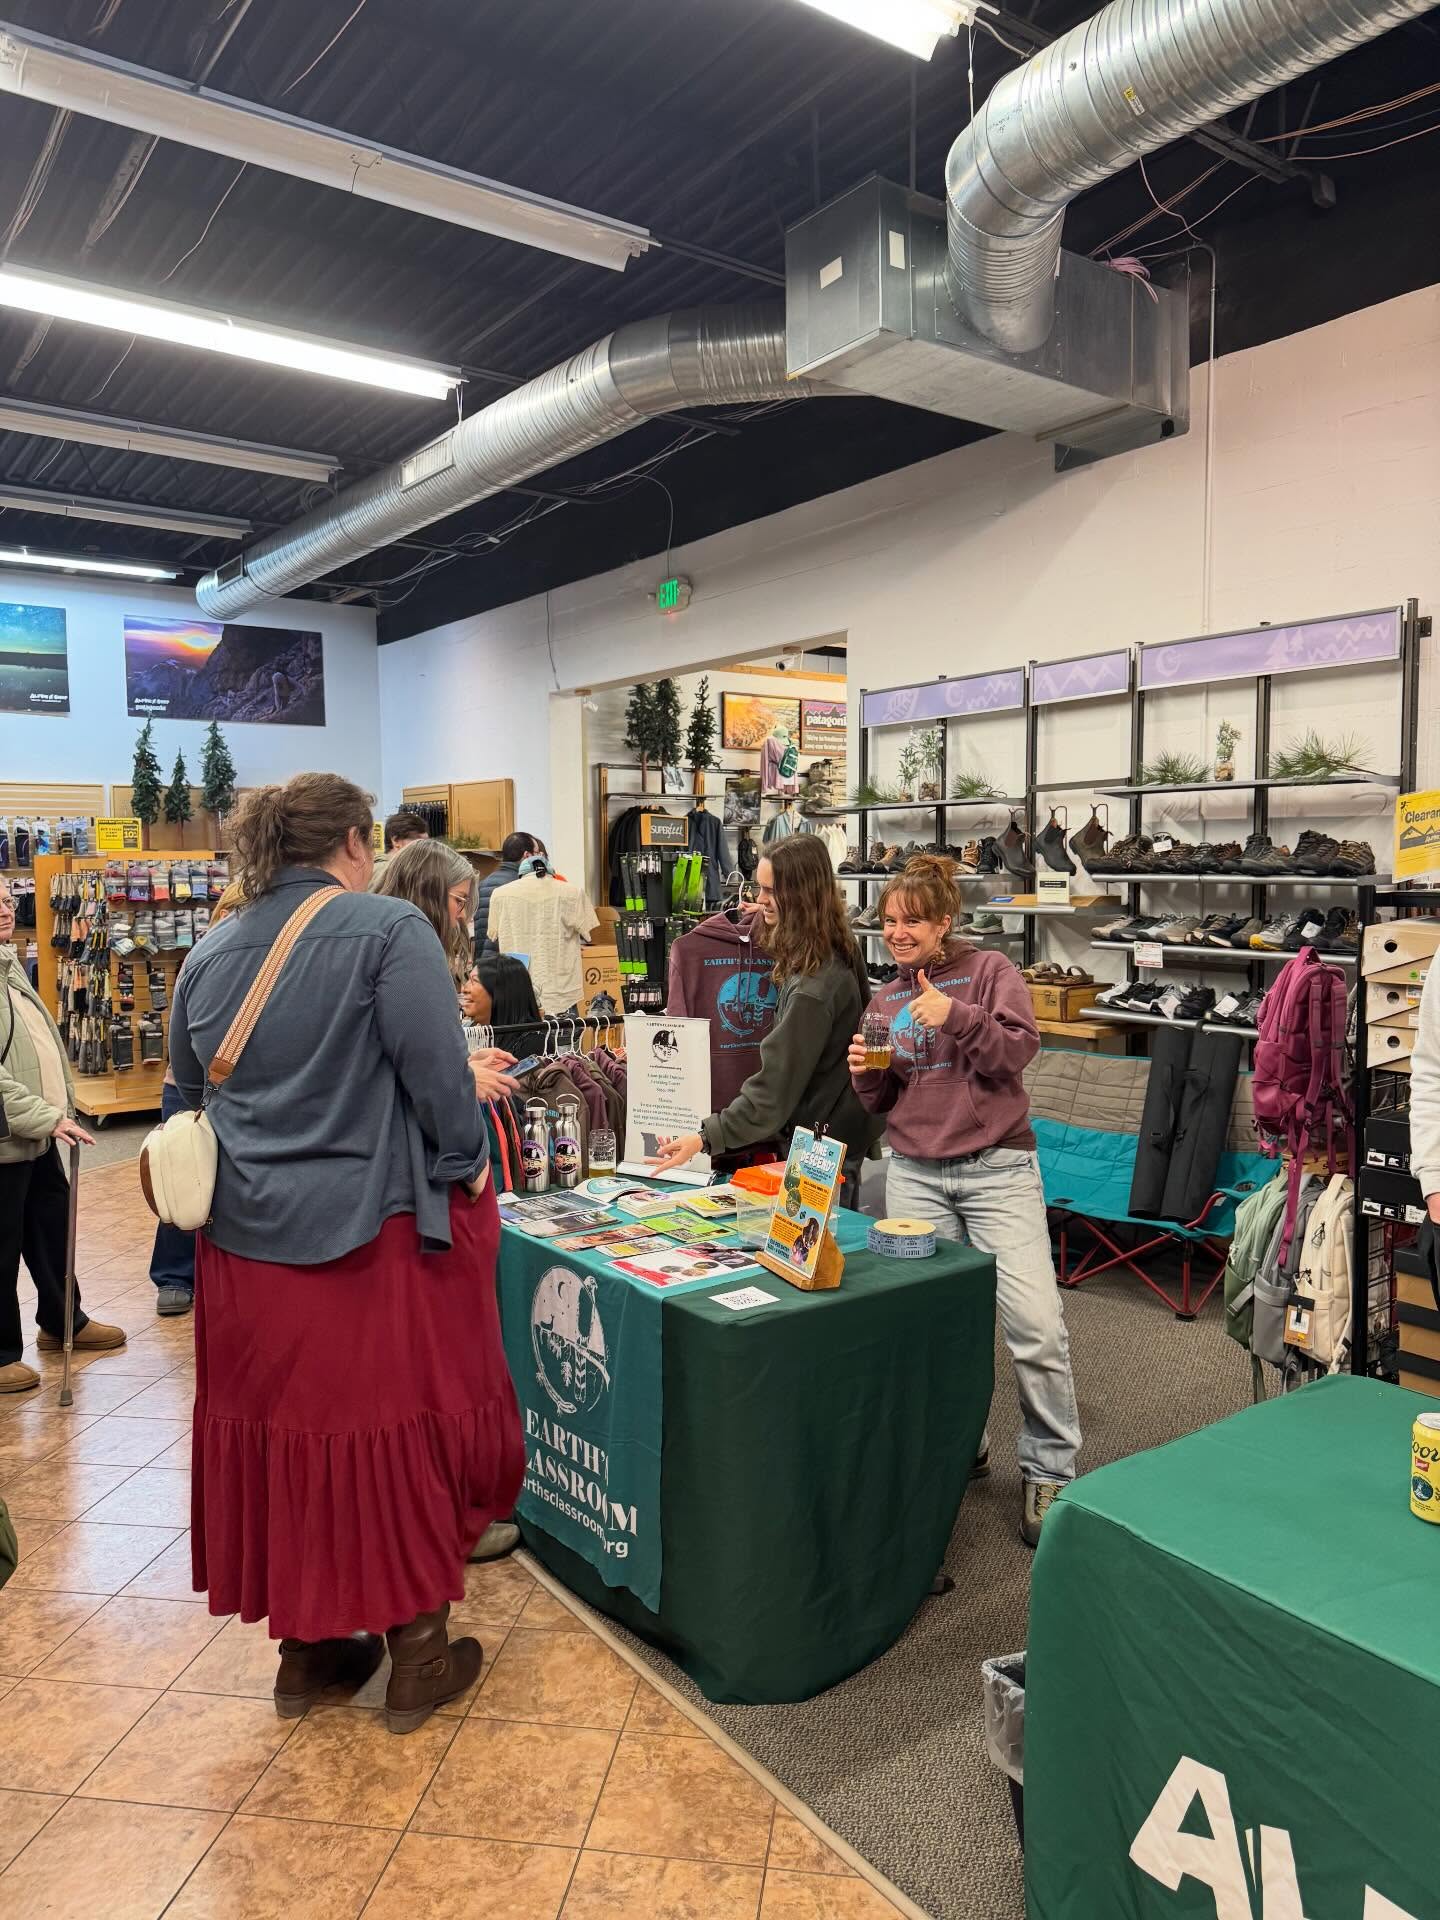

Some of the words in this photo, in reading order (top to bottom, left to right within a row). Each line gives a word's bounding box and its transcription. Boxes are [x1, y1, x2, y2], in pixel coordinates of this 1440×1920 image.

[658, 578, 679, 609] EXIT
[806, 714, 847, 728] patagoni
[744, 958, 775, 966] CLASS
[886, 988, 912, 1002] EARTH
[526, 1448, 639, 1537] ASSROOM
[522, 1475, 629, 1558] arthsclassroomrg
